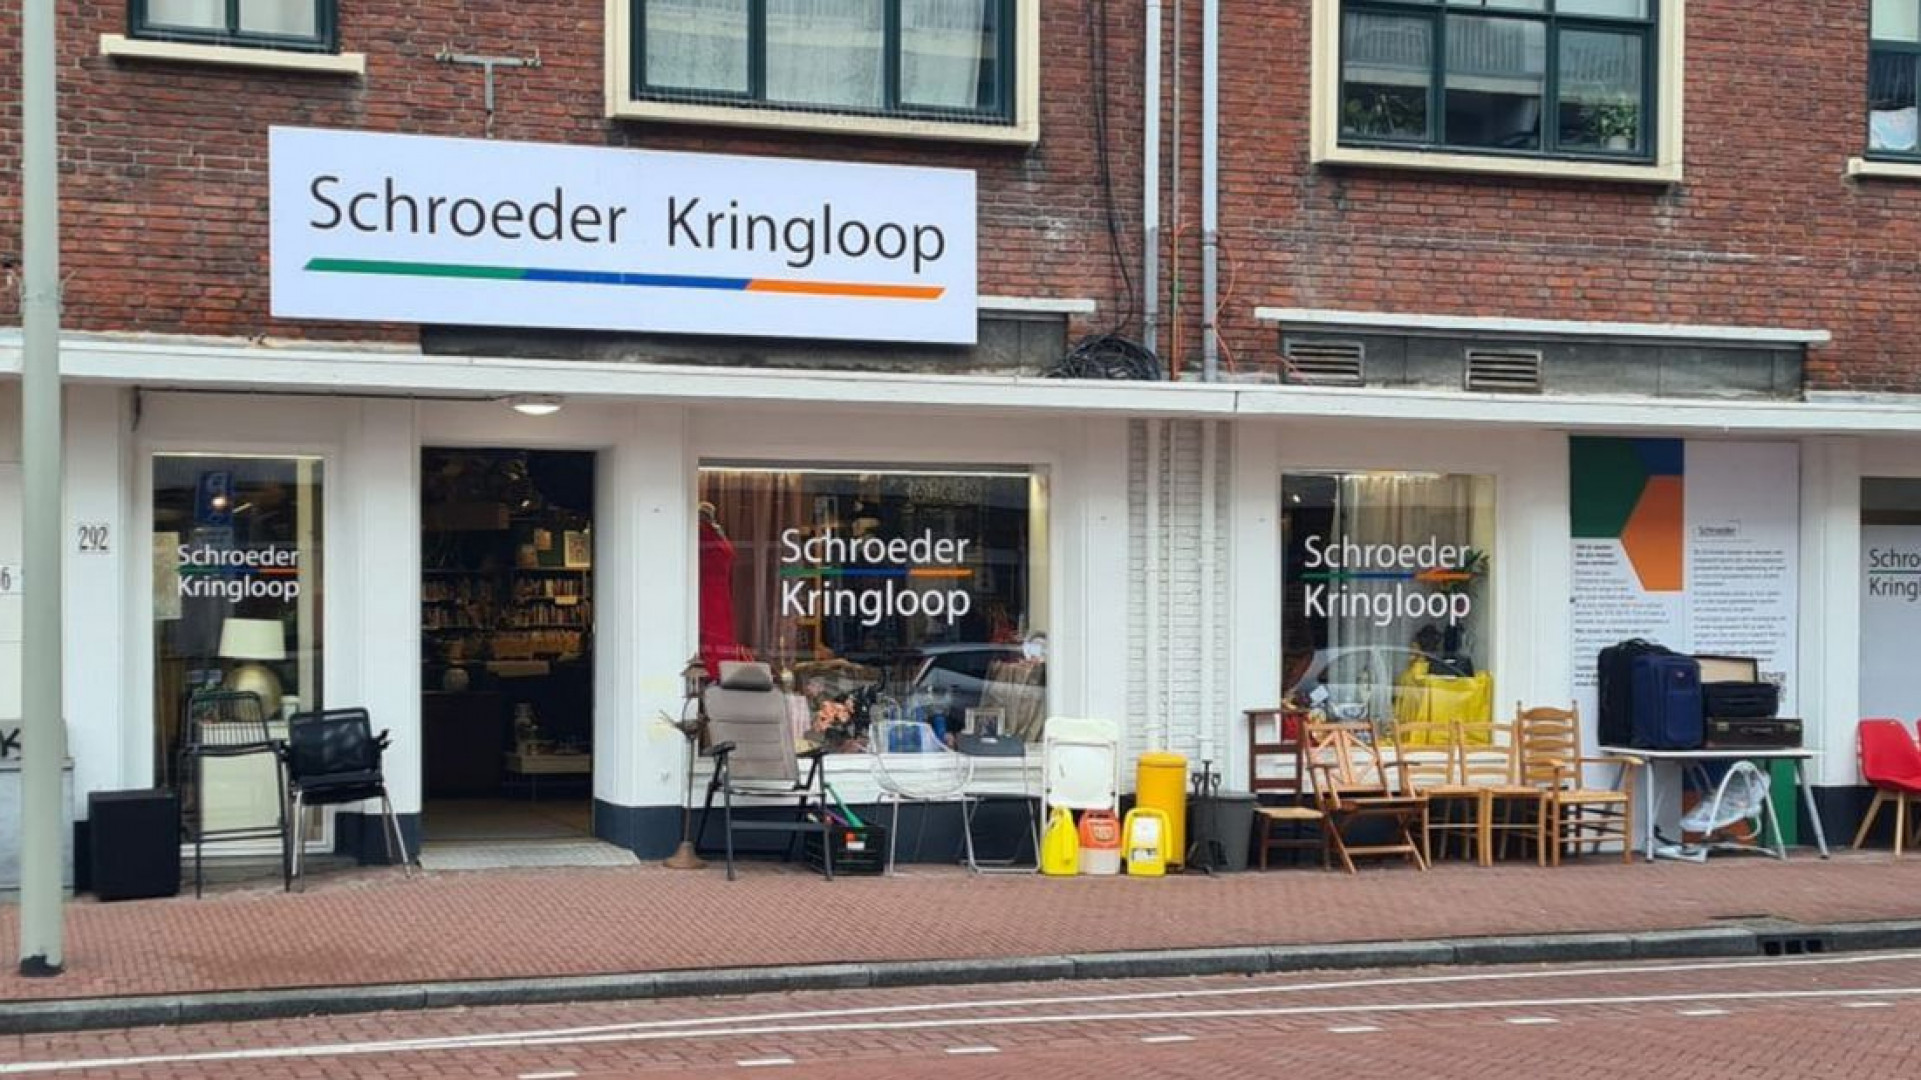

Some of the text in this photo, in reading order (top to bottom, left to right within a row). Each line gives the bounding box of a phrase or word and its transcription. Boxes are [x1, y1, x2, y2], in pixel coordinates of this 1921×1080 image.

[309, 175, 945, 274] Schroeder Kringloop
[79, 525, 109, 551] 292
[177, 543, 300, 565] Schroeder
[780, 527, 970, 563] Schroeder
[1304, 534, 1470, 568] Schroeder
[1868, 547, 1921, 568] Schro
[177, 575, 301, 603] Kringloop
[780, 579, 971, 625] Kringloop
[1304, 584, 1471, 626] Kringloop
